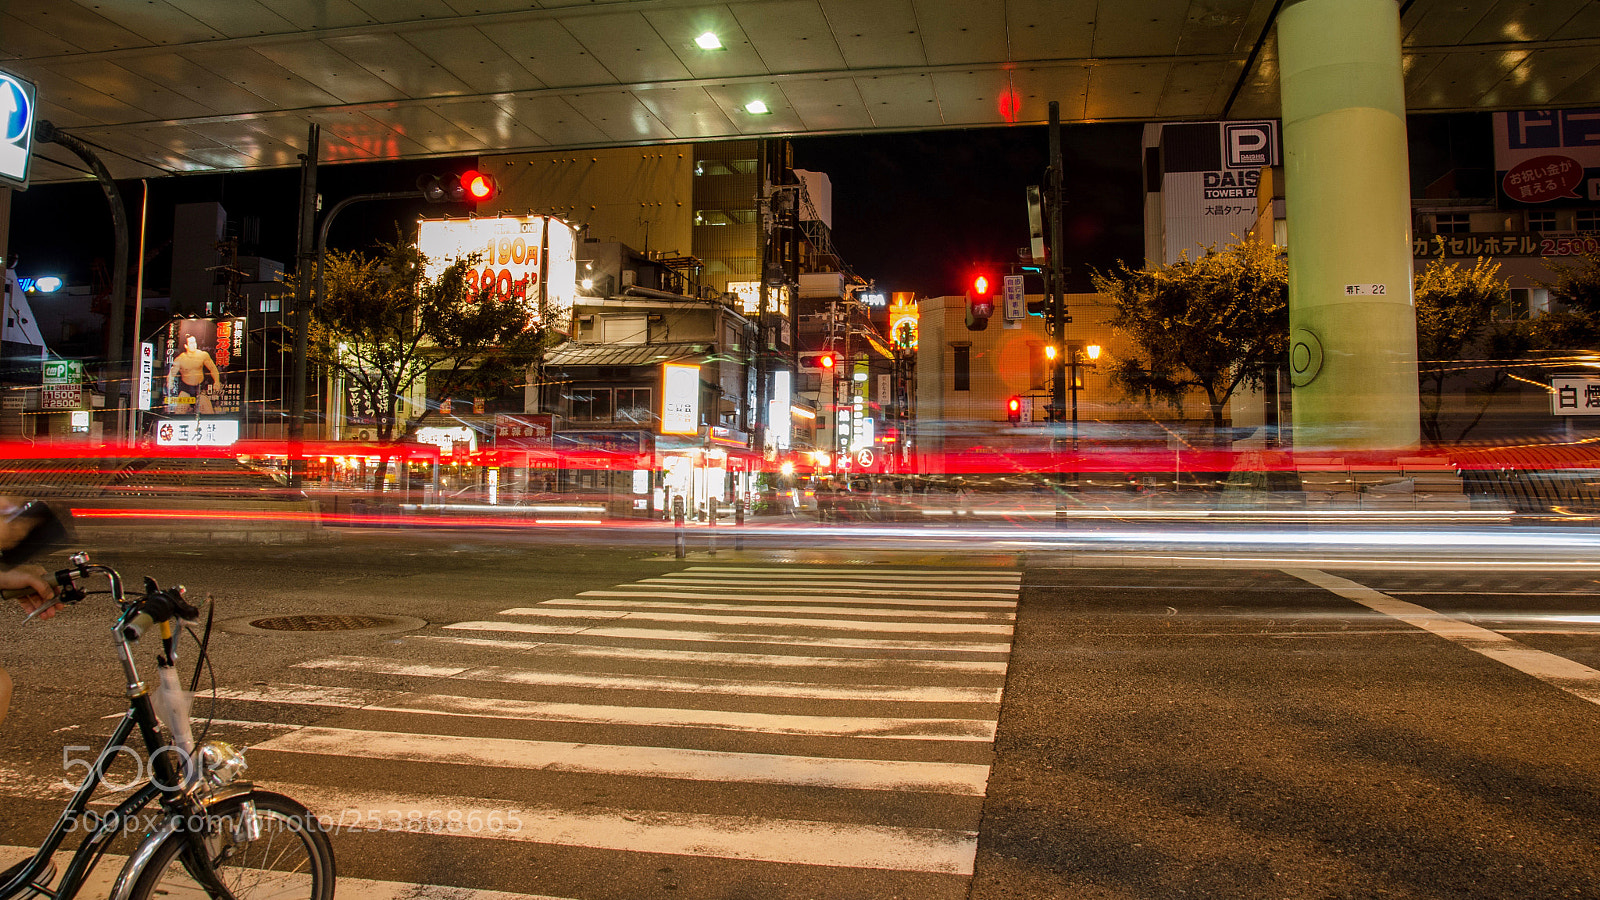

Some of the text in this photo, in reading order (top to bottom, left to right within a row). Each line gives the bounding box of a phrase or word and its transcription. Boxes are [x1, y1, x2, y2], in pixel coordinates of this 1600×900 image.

[1231, 129, 1266, 163] P
[1510, 159, 1572, 185] お祝い金が
[1206, 190, 1243, 198] TOWER
[1414, 236, 1537, 255] カプセルホテル
[1372, 284, 1385, 294] 22
